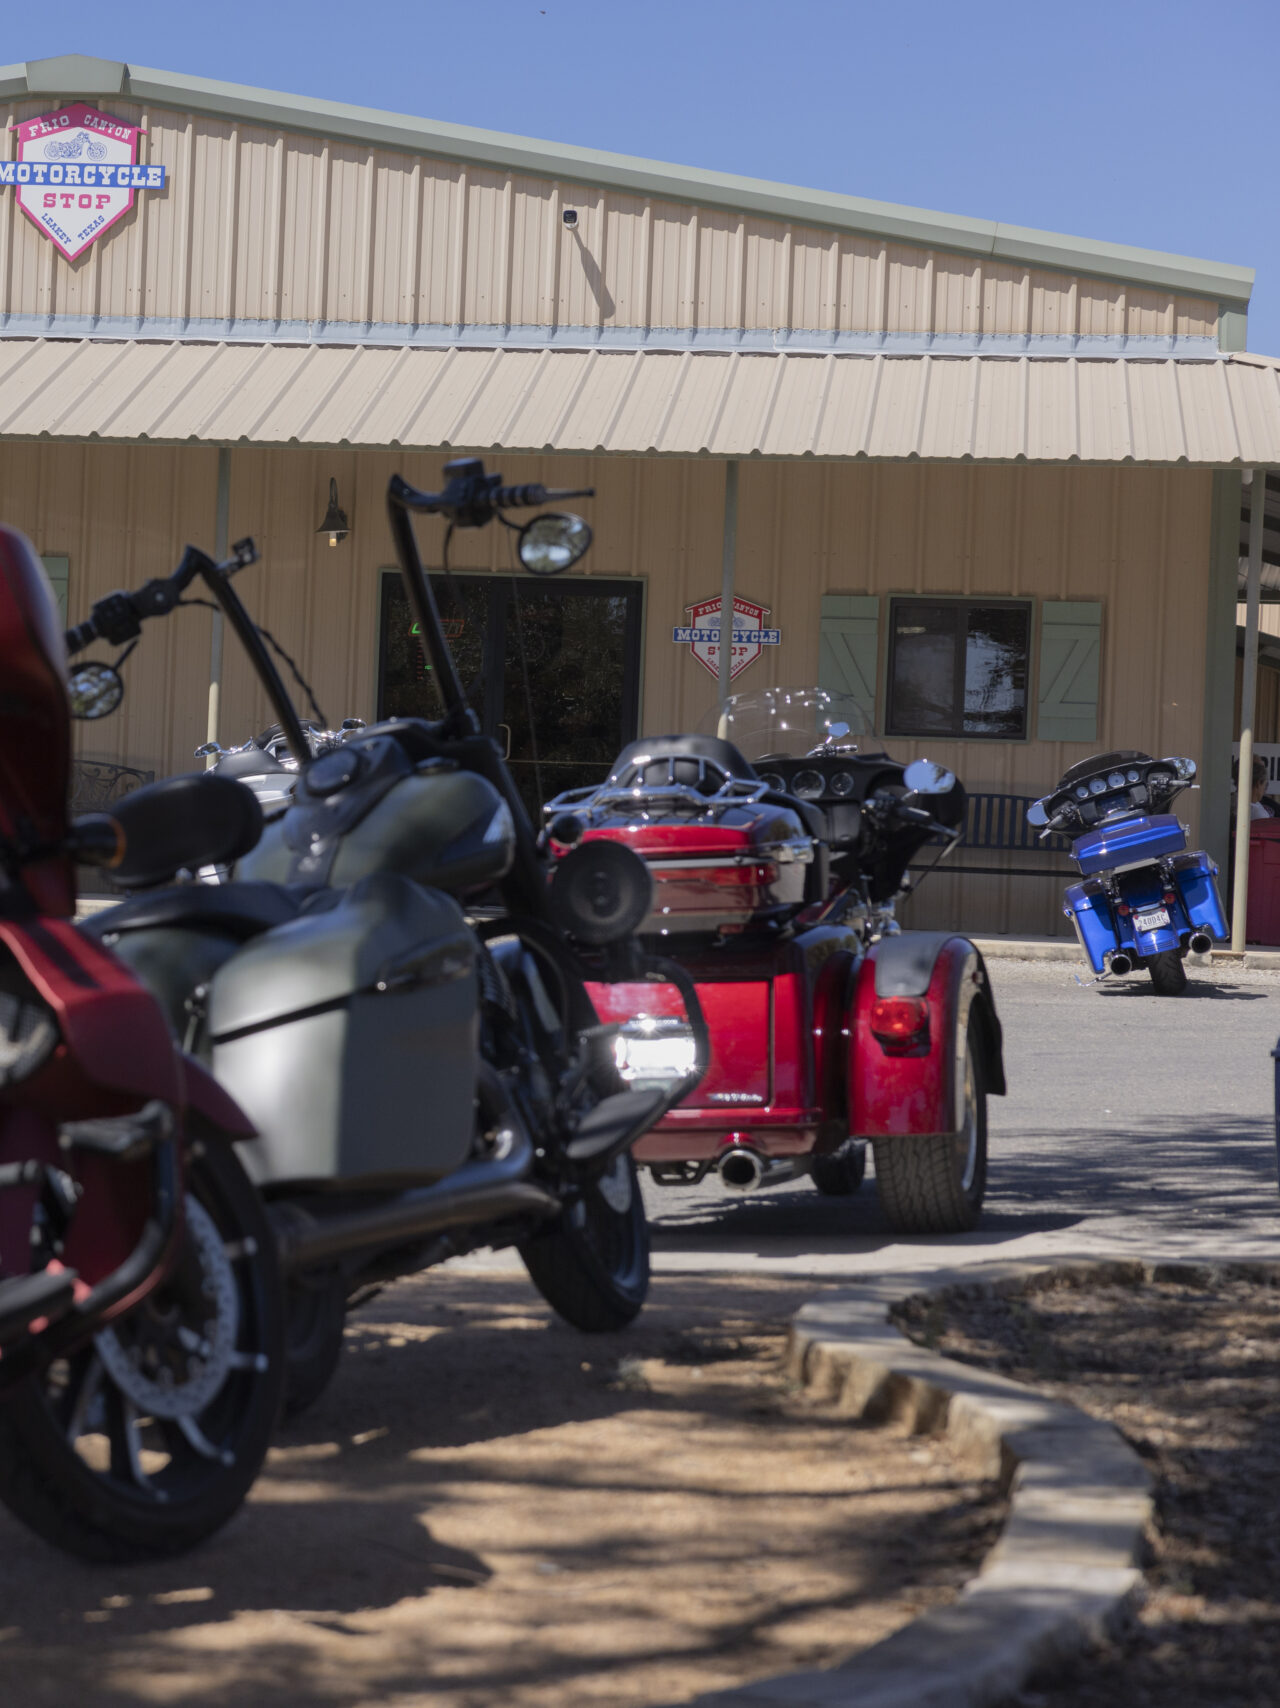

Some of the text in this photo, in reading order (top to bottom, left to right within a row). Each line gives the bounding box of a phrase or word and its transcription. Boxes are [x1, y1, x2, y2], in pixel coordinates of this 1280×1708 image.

[28, 114, 132, 140] FRIO CANYON
[43, 192, 111, 210] STOP
[41, 212, 106, 245] LEAKEY TEXAS
[733, 602, 760, 616] ANYON
[677, 629, 779, 642] MOTOCYCLE
[707, 646, 748, 657] SOP
